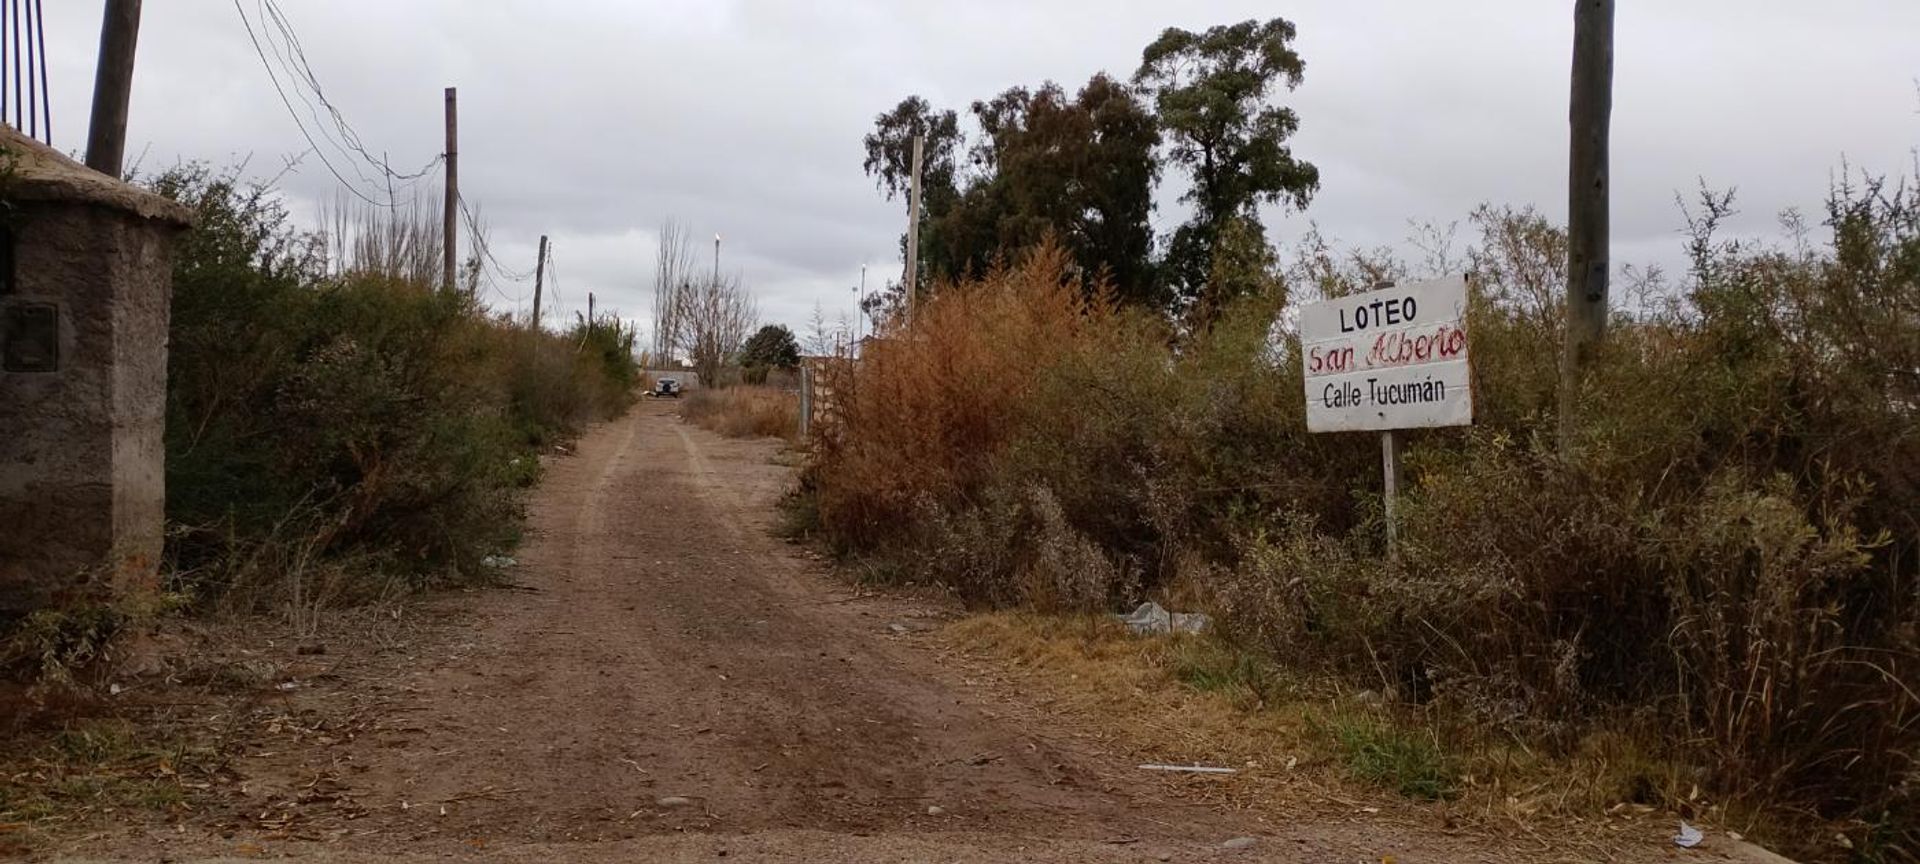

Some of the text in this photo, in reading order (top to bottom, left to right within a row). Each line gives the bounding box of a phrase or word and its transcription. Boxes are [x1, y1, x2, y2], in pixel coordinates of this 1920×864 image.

[1339, 296, 1417, 333] LOTEO
[1309, 326, 1466, 373] San Alberto
[1323, 374, 1445, 409] Calle Tucumán
